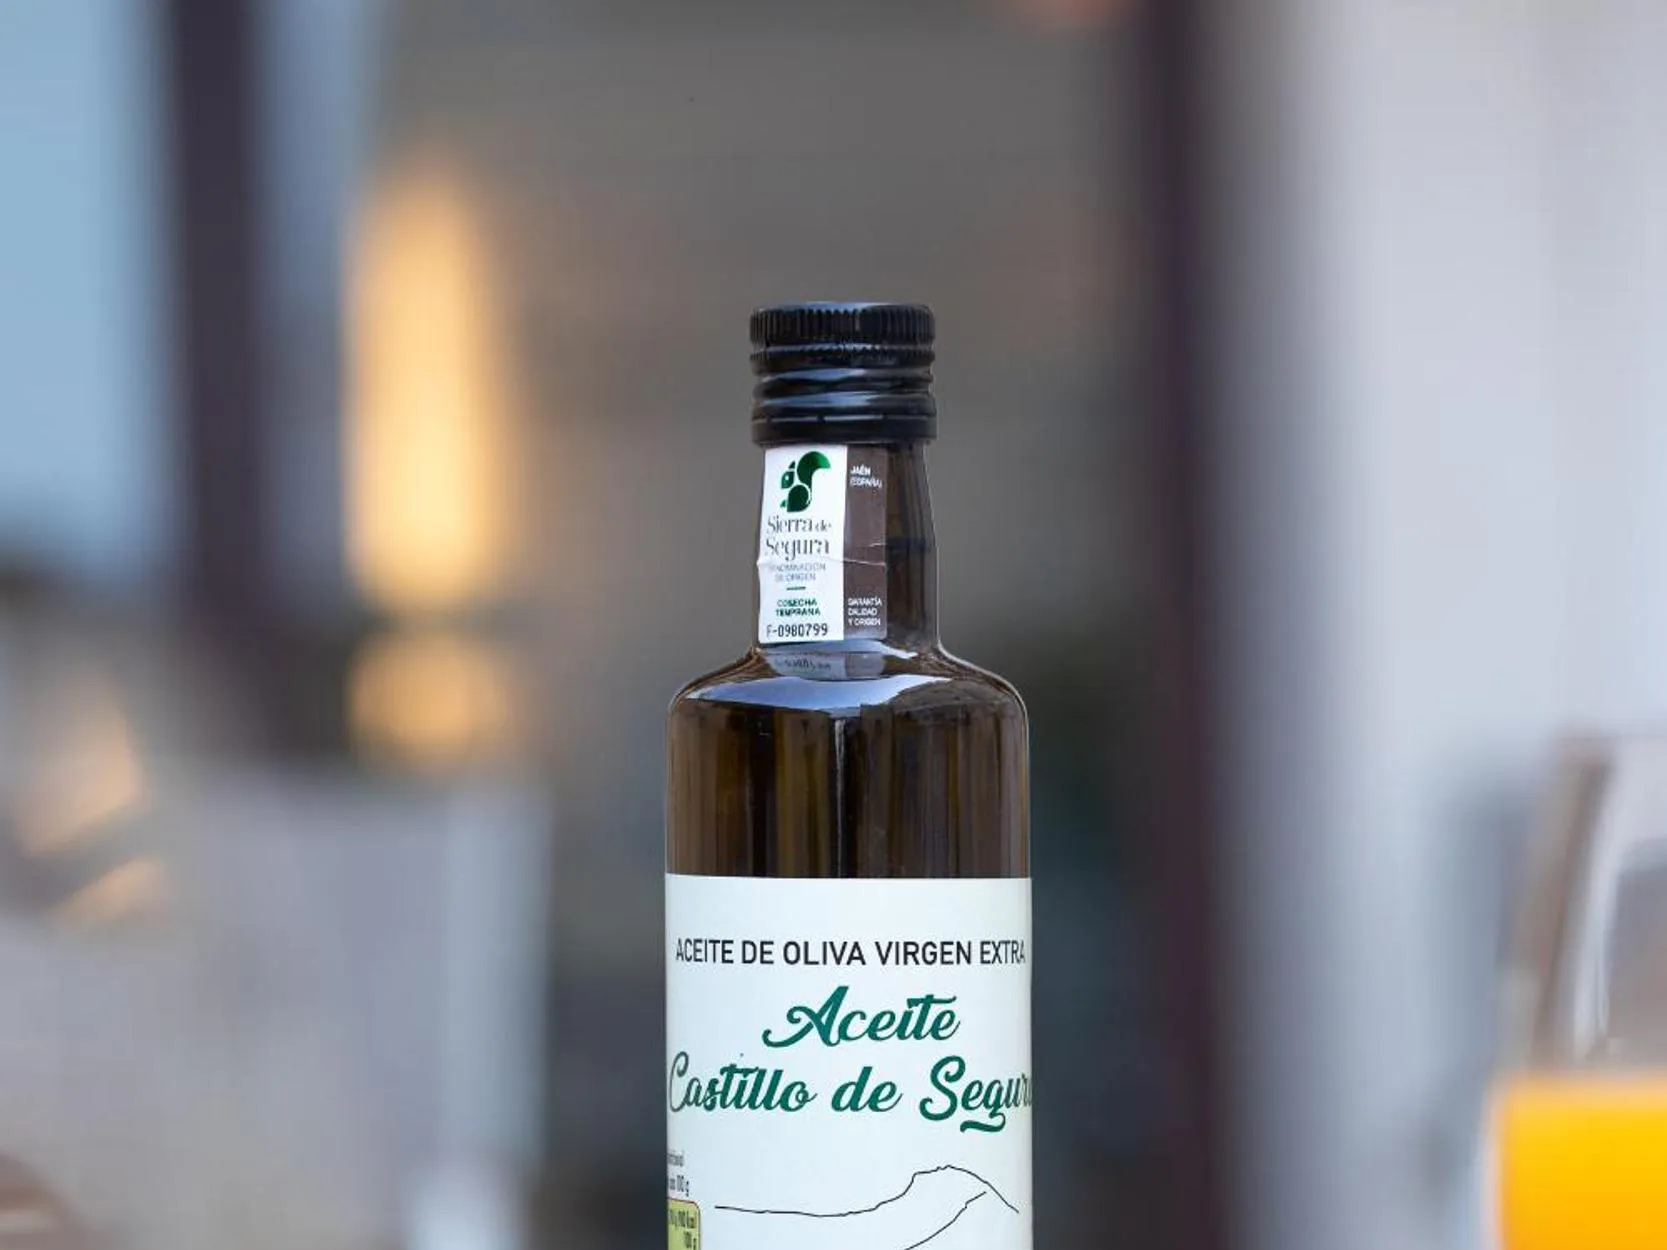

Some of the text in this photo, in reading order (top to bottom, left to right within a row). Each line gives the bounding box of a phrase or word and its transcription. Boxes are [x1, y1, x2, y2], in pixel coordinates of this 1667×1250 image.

[851, 465, 871, 475] JAÉN
[767, 515, 831, 534] Sierra de
[765, 537, 830, 561] Segura
[775, 607, 821, 617] TEMPRANA
[777, 599, 818, 608] COSECHA
[766, 623, 829, 639] F-0980799
[676, 938, 1025, 966] ACEITE DE OLIVA VIRGEN EXTRA
[762, 985, 961, 1048] Aceite
[669, 1051, 818, 1113] Castillo
[831, 1066, 903, 1113] de
